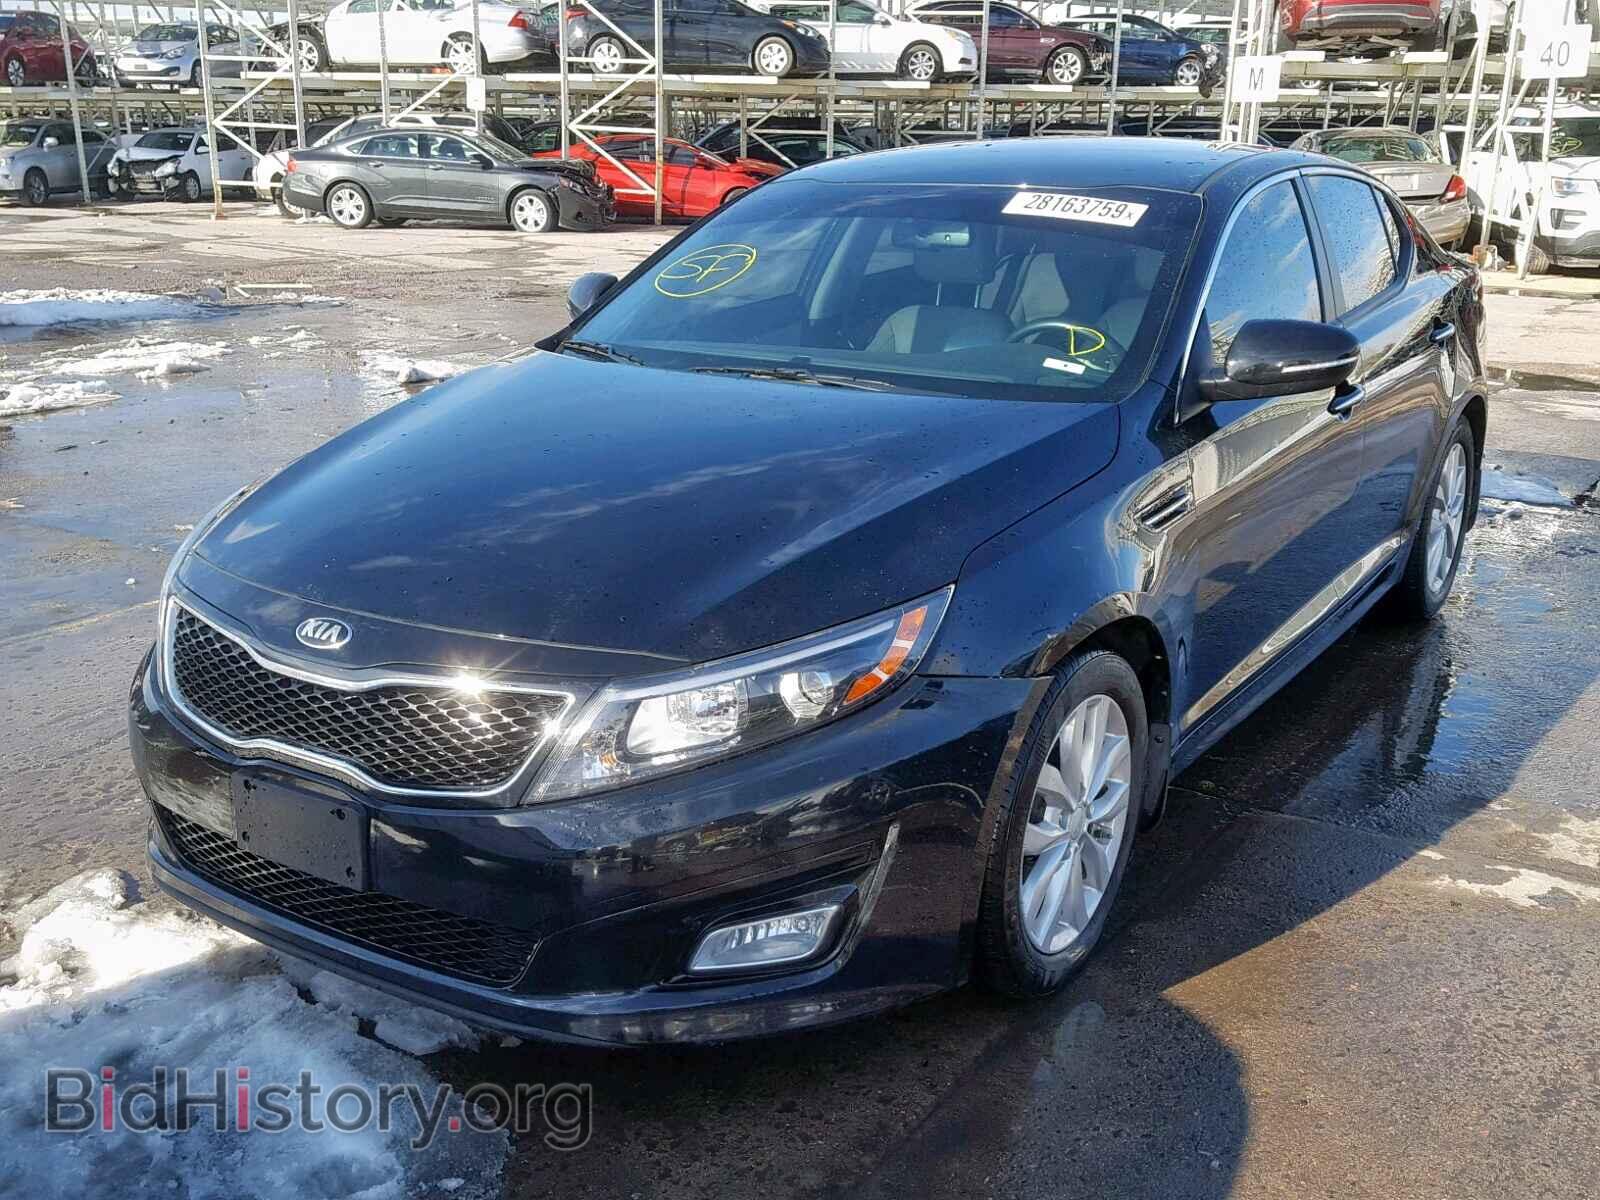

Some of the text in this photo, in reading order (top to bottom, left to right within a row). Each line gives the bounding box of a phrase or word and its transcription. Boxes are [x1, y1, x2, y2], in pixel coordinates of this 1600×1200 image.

[1539, 40, 1570, 67] 40
[1248, 66, 1264, 91] M
[1023, 194, 1128, 219] 28163759
[300, 620, 343, 644] KIA
